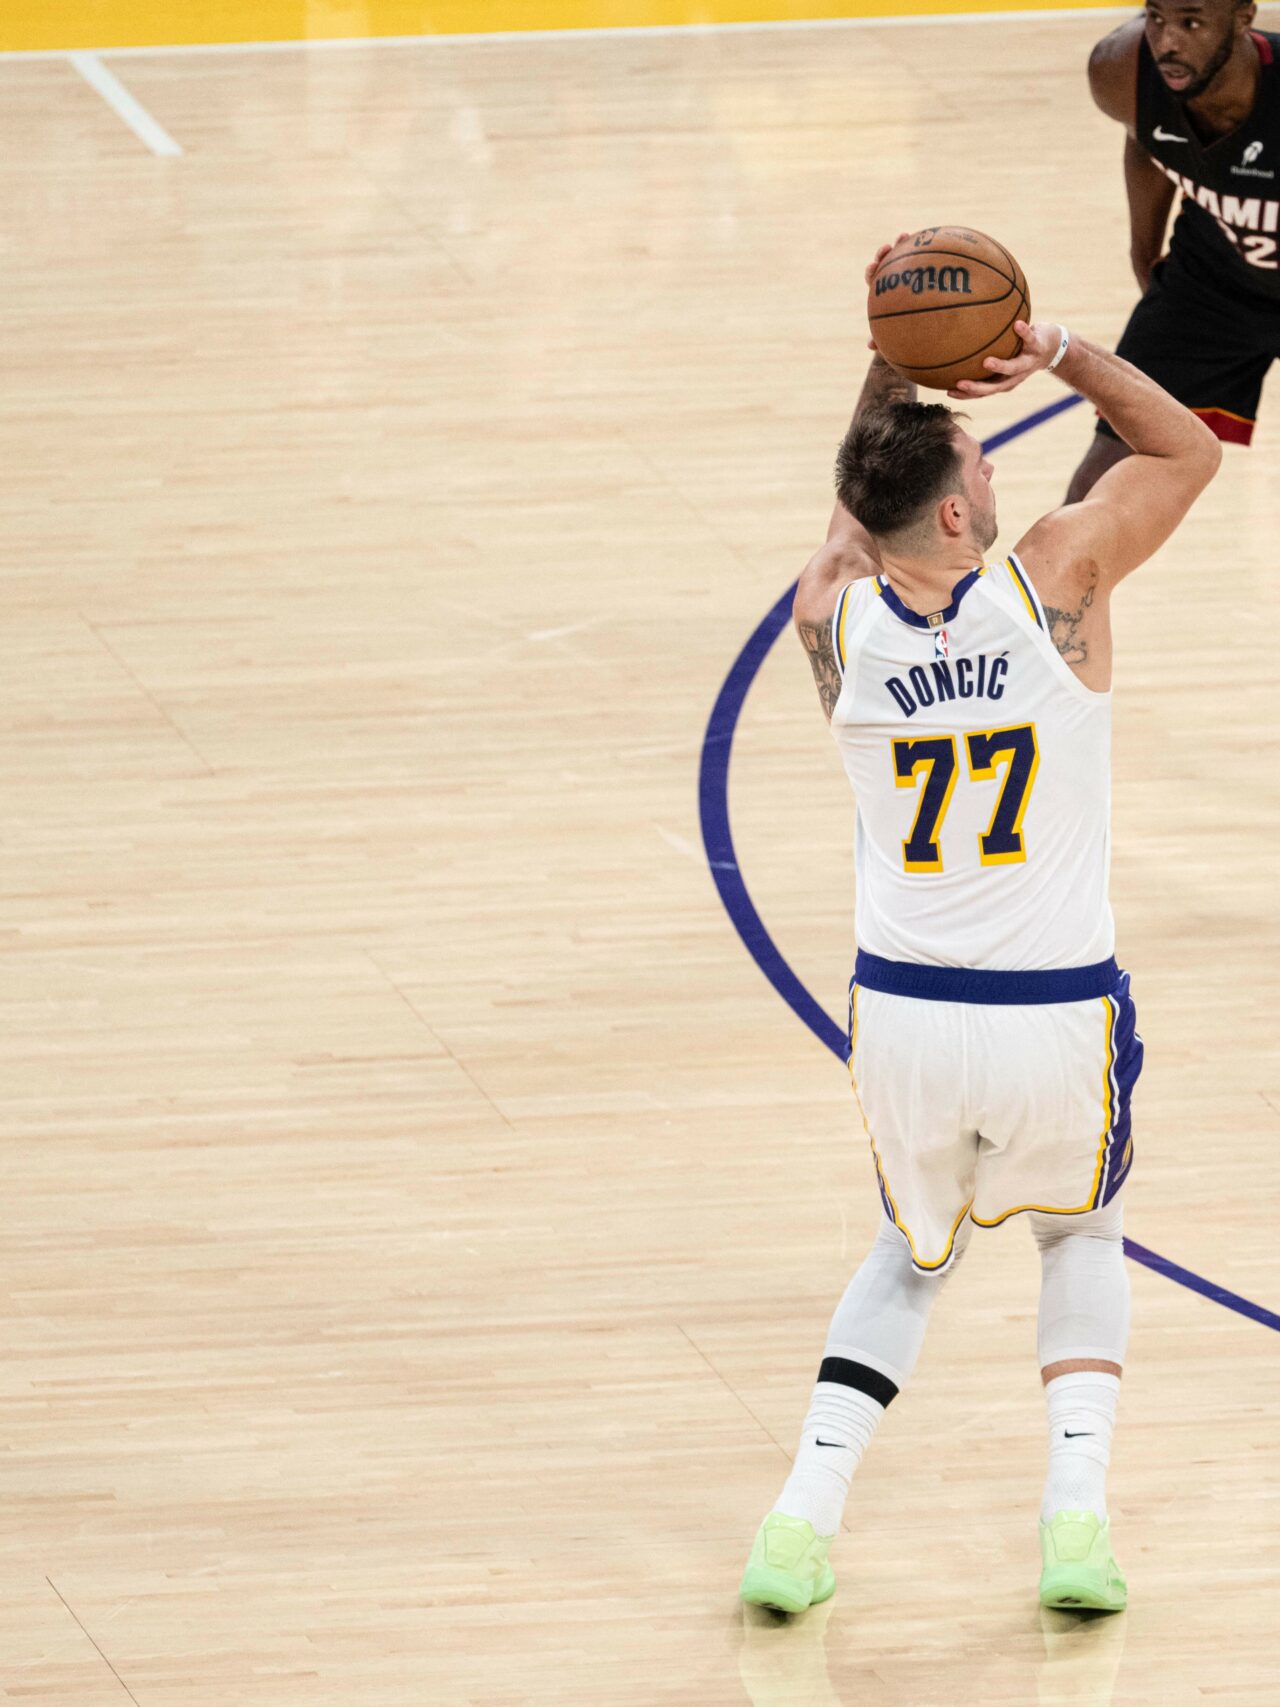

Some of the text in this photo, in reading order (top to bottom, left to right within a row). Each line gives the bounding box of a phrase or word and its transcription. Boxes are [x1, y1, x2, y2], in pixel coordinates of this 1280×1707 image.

[1151, 156, 1280, 233] AMI
[1216, 219, 1279, 269] 2
[875, 265, 972, 297] Wilson
[890, 721, 1040, 873] 77
